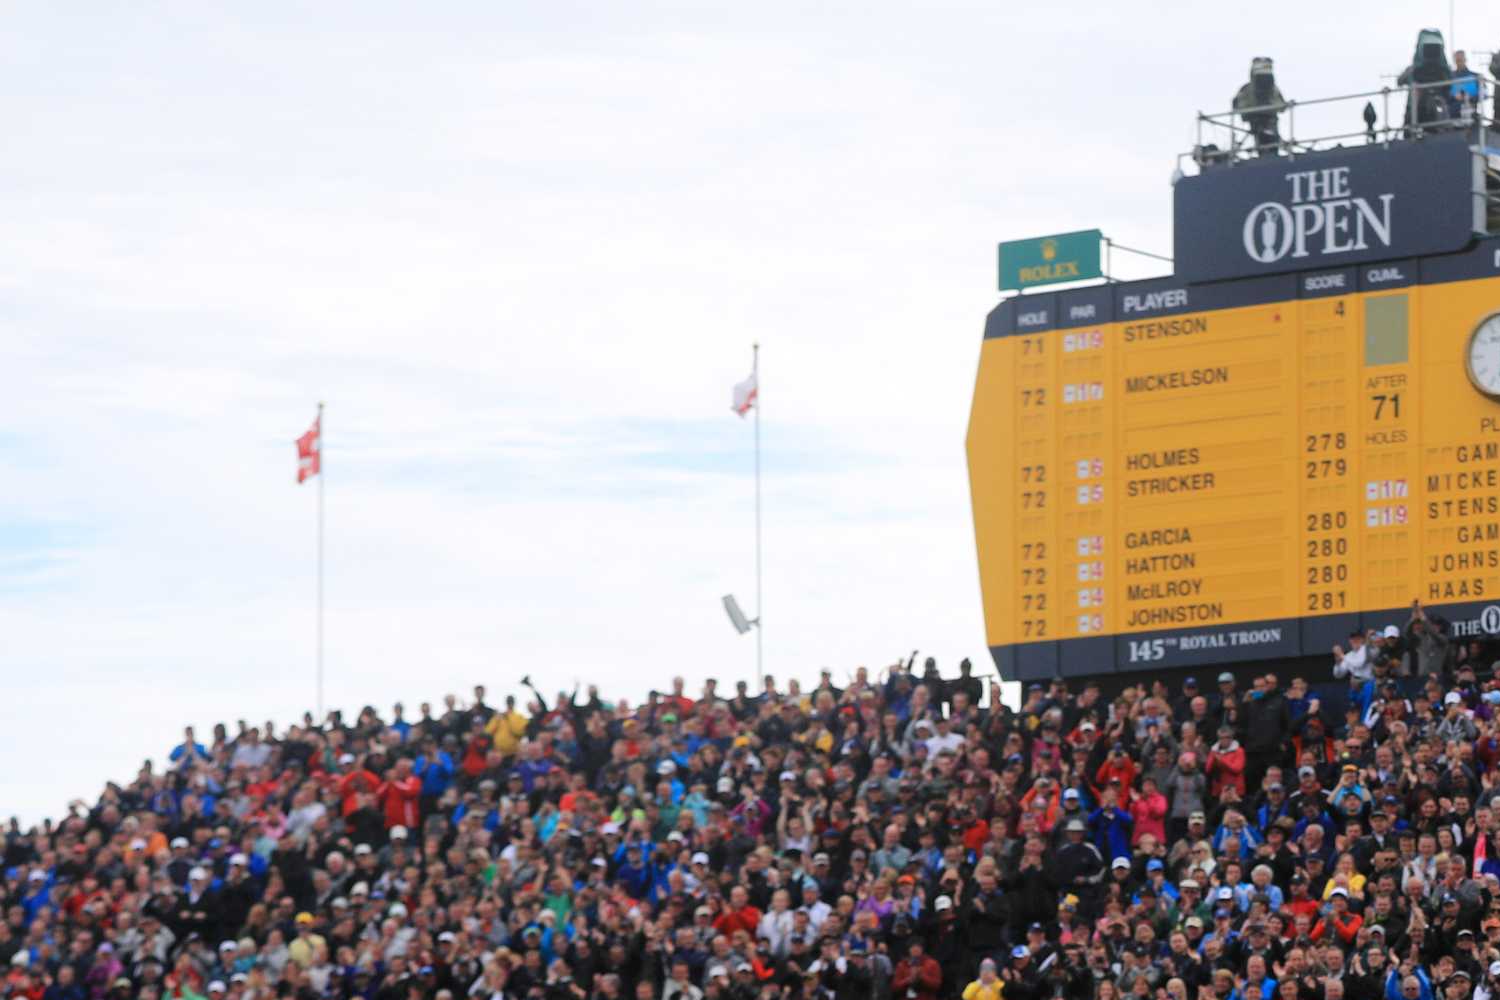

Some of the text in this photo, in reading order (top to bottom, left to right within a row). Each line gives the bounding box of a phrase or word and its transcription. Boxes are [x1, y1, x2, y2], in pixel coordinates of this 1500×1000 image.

[1285, 167, 1351, 203] THE
[1243, 194, 1395, 263] OPEN
[1019, 261, 1079, 282] ROLEX
[1305, 274, 1345, 290] SCORE
[1123, 289, 1188, 312] PLAYER
[1335, 301, 1345, 316] 4
[1018, 310, 1048, 326] HOLE
[1070, 305, 1096, 319] PAR
[1124, 318, 1208, 342] STENSON
[1023, 338, 1044, 354] 71
[1126, 367, 1229, 393] MICKELSON
[1366, 374, 1408, 391] AFTER
[1022, 388, 1046, 406] 72
[1372, 394, 1401, 421] 71
[1307, 432, 1347, 453] 278
[1366, 430, 1408, 445] HOLES
[1127, 448, 1200, 471] HOLMES
[1307, 459, 1347, 480] 279
[1022, 465, 1046, 482] 72
[1127, 473, 1215, 497] STRICKER
[1366, 479, 1409, 500] -17
[1022, 491, 1046, 508] 72
[1307, 511, 1347, 532] 280
[1366, 507, 1409, 528] -19
[1125, 528, 1192, 549] GARCIA
[1307, 538, 1347, 558] 280
[1022, 543, 1046, 560] 72
[1126, 553, 1196, 575] HATTON
[1307, 564, 1347, 585] 280
[1022, 568, 1046, 586] 72
[1128, 579, 1203, 602] McILROY
[1429, 578, 1485, 600] HAAS
[1022, 594, 1046, 612] 72
[1307, 591, 1347, 610] 281
[1127, 602, 1224, 627] JOHNSTON
[1022, 620, 1046, 637] 72
[1179, 632, 1228, 650] ROYAL
[1229, 628, 1283, 646] TROON
